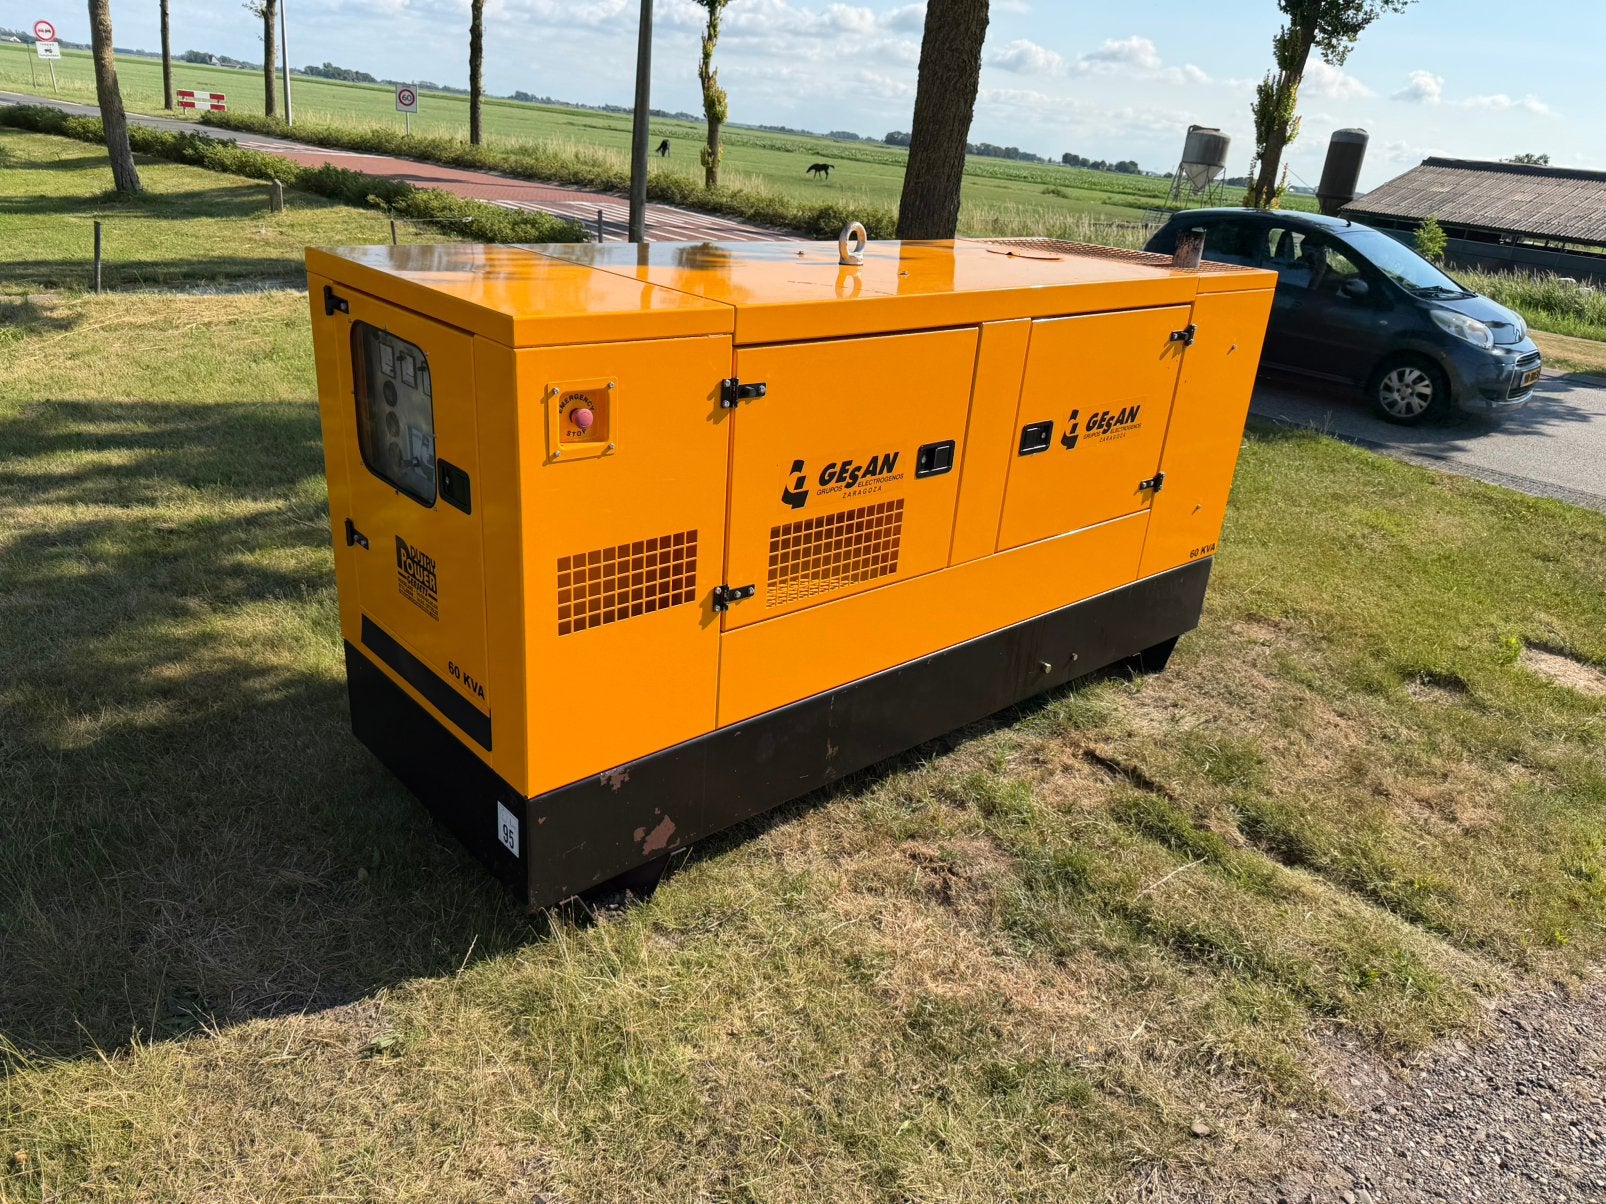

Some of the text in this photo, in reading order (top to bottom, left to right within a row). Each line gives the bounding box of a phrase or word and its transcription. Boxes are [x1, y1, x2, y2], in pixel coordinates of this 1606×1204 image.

[559, 393, 595, 414] EMERGENCY
[1083, 423, 1142, 440] GRUPOS ELECTROGENOS
[1099, 433, 1126, 443] ZARAGOZA
[816, 473, 904, 496] GRUPOS ELECTROGENOS
[842, 486, 882, 499] ZARAGOZA
[410, 545, 436, 574] DUTRY
[1189, 543, 1216, 559] 60 KVA
[401, 547, 437, 592] POWER
[448, 661, 485, 700] 60 KVA
[503, 824, 514, 849] 95
